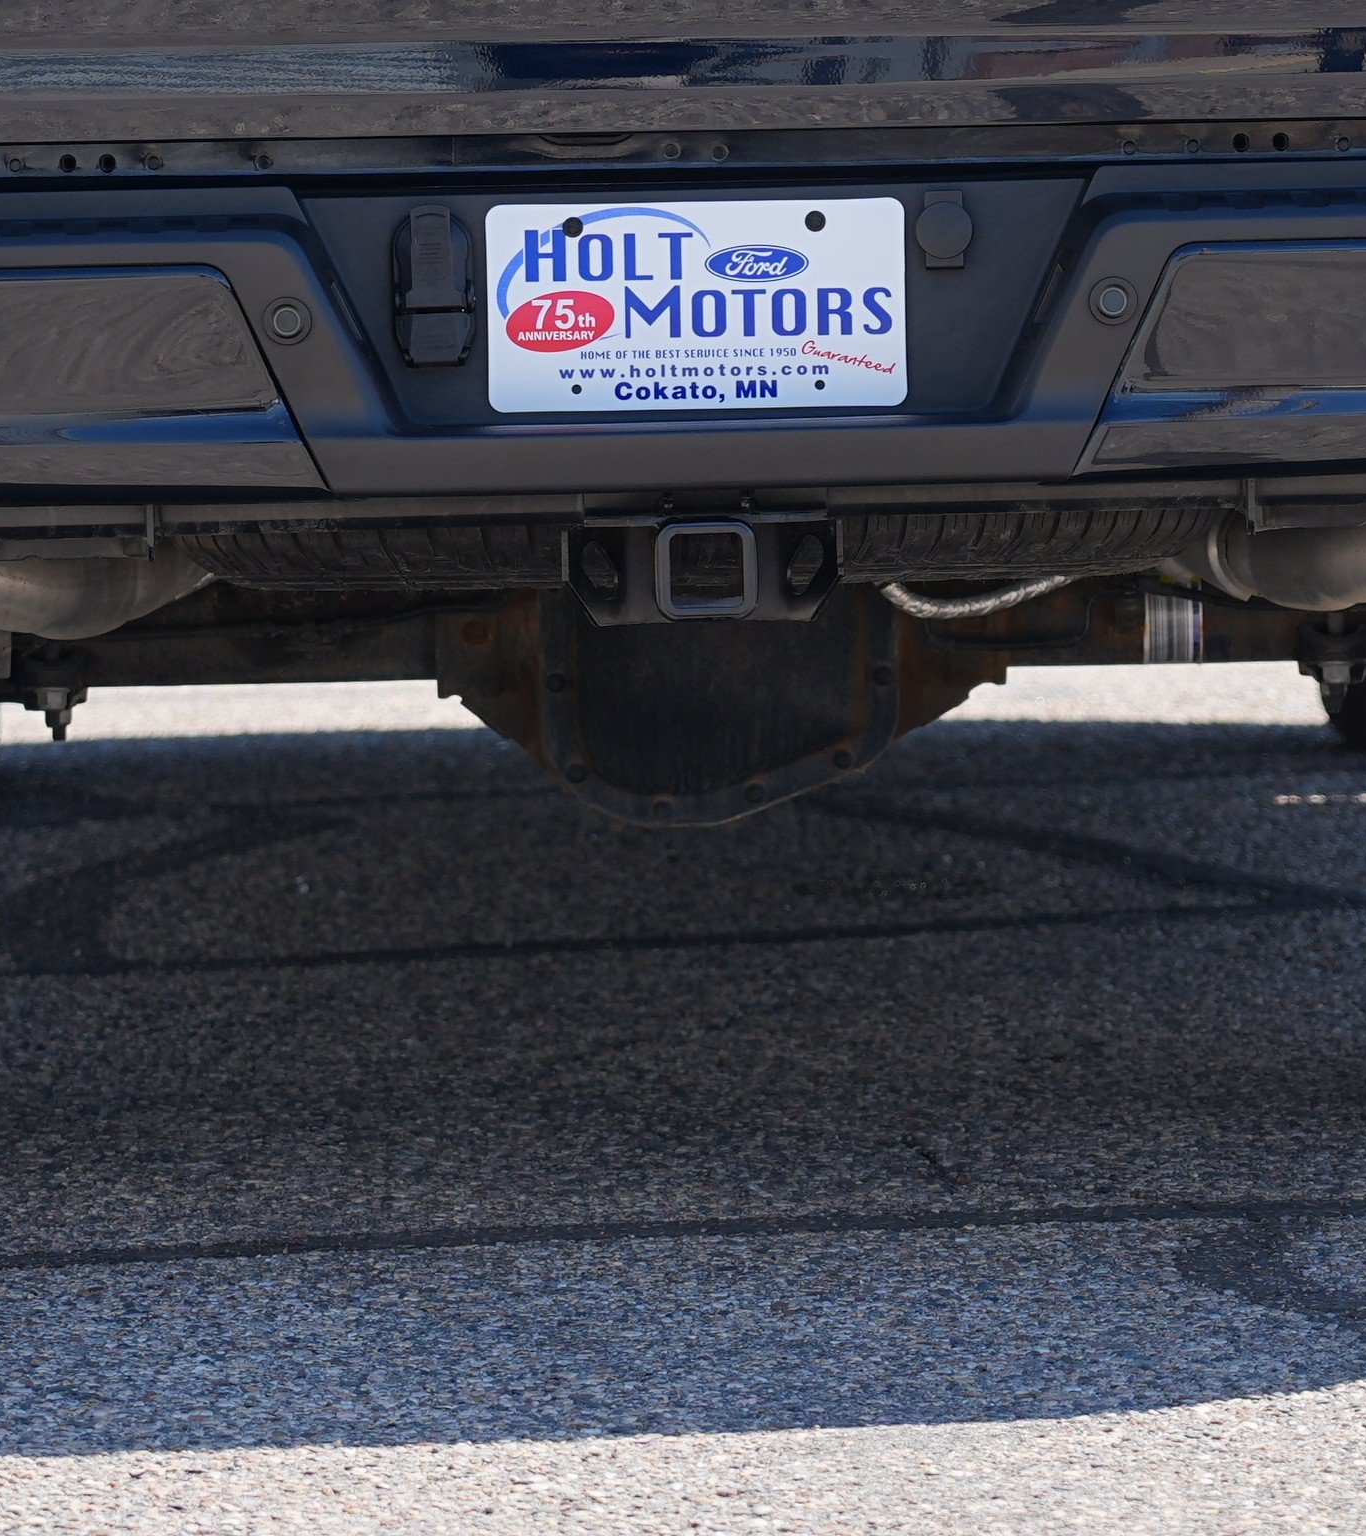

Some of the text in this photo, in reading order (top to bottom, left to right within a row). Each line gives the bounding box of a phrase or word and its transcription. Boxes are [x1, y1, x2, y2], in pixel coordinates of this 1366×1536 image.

[524, 229, 694, 283] HOLT
[724, 249, 788, 277] Ford
[531, 298, 596, 330] 75th
[625, 285, 893, 340] MOTORS
[517, 330, 595, 342] ANNIVERSARY
[580, 346, 797, 360] HOME OF THE BEST SERVICE SINCE 1950
[801, 339, 896, 375] Guaranteed
[559, 363, 829, 379] www.holtmotors.com
[614, 379, 778, 403] Cokato, MN
